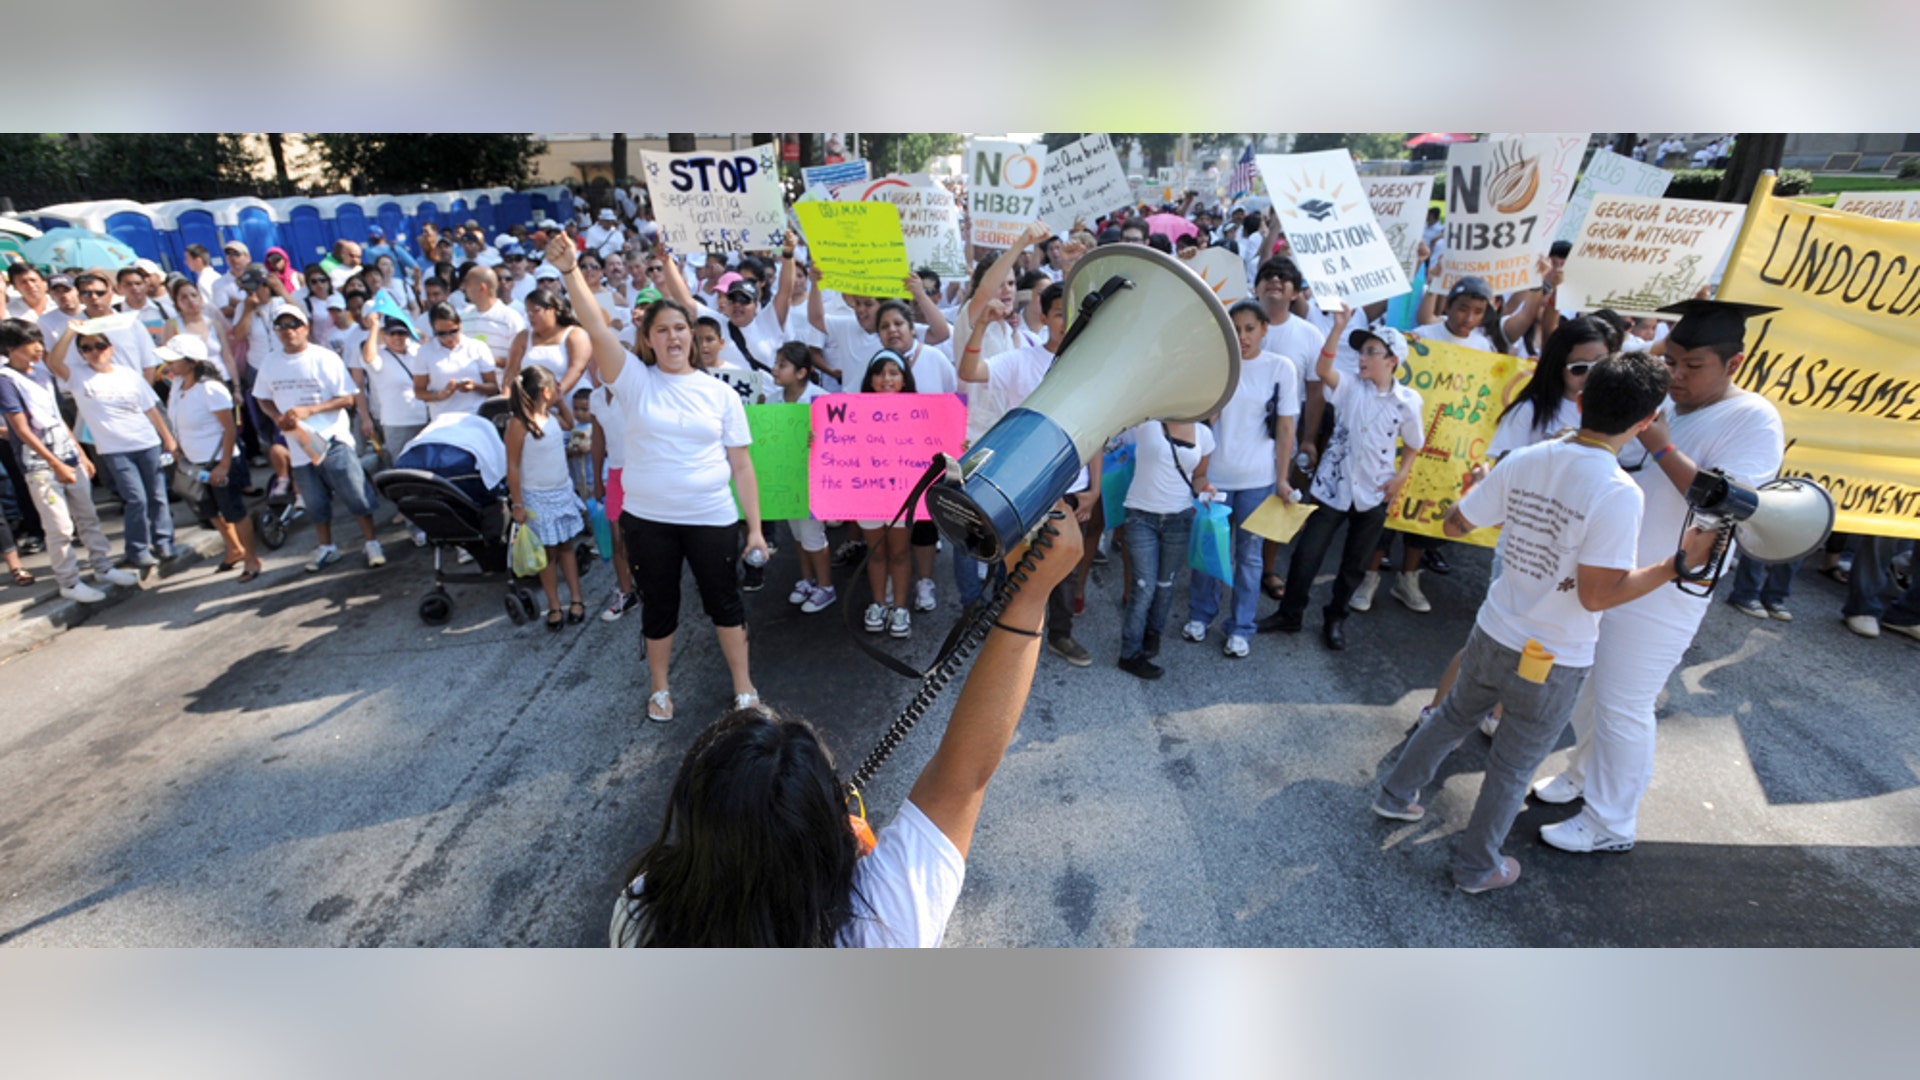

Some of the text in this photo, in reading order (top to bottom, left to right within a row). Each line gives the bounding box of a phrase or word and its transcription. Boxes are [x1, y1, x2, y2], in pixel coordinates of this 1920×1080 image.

[669, 156, 758, 193] STOP
[974, 151, 1038, 190] NO
[973, 192, 1035, 216] HB87
[1595, 200, 1661, 223] GEORGIA
[1665, 205, 1735, 230] DOESN'T
[699, 238, 745, 251] THIS
[1290, 222, 1377, 255] EDUCATION
[1446, 214, 1538, 251] HB87
[1586, 221, 1634, 241] GROW
[1634, 224, 1703, 249] WITHOUT
[1322, 254, 1352, 276] IS A
[1494, 252, 1531, 270] ROTS
[1577, 241, 1671, 266] IMMIGRANTS
[1760, 213, 1920, 317] UNDOCU
[1350, 265, 1397, 293] RIGHT
[1733, 316, 1920, 422] NASHAME
[827, 401, 930, 424] We are all
[866, 433, 886, 446] and
[895, 435, 916, 447] we
[924, 434, 943, 447] all
[871, 456, 889, 469] be
[821, 474, 843, 490] the
